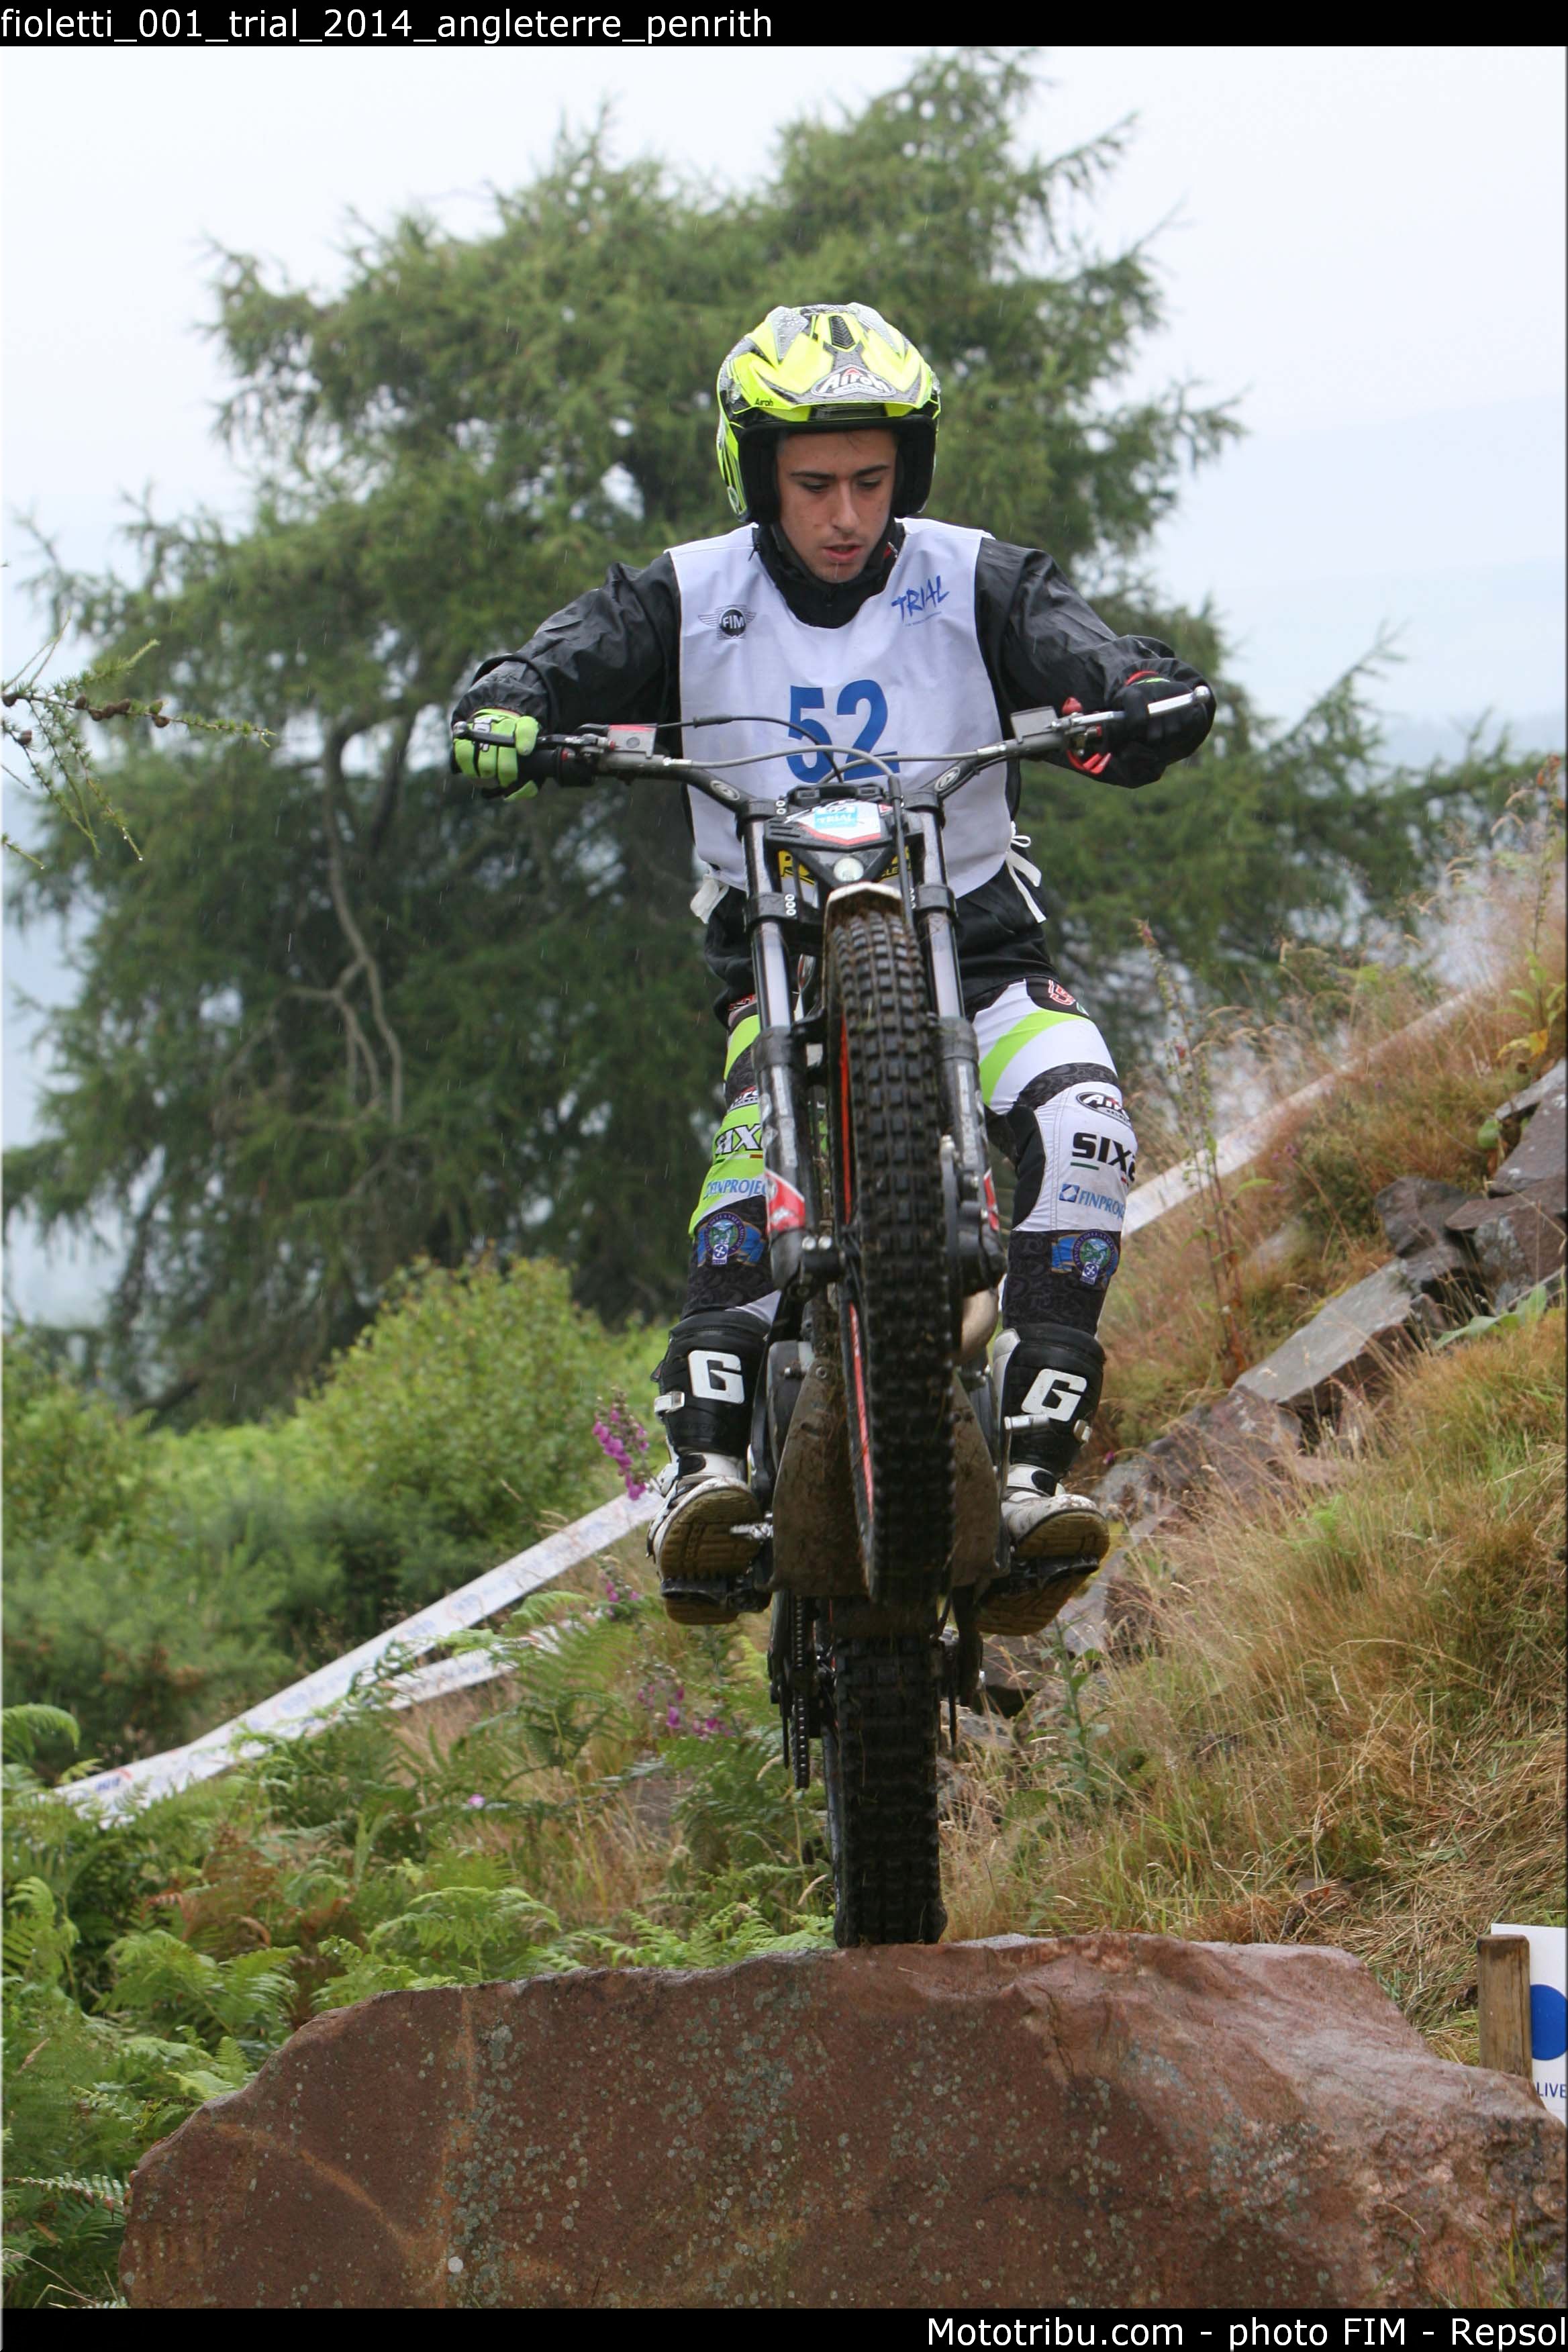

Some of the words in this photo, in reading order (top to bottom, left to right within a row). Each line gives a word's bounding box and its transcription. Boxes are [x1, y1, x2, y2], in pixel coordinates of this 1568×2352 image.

[722, 615, 745, 629] FIM
[891, 575, 950, 622] TRIAL
[786, 679, 900, 783] 52
[688, 1350, 745, 1404] G
[1021, 1369, 1087, 1421] G
